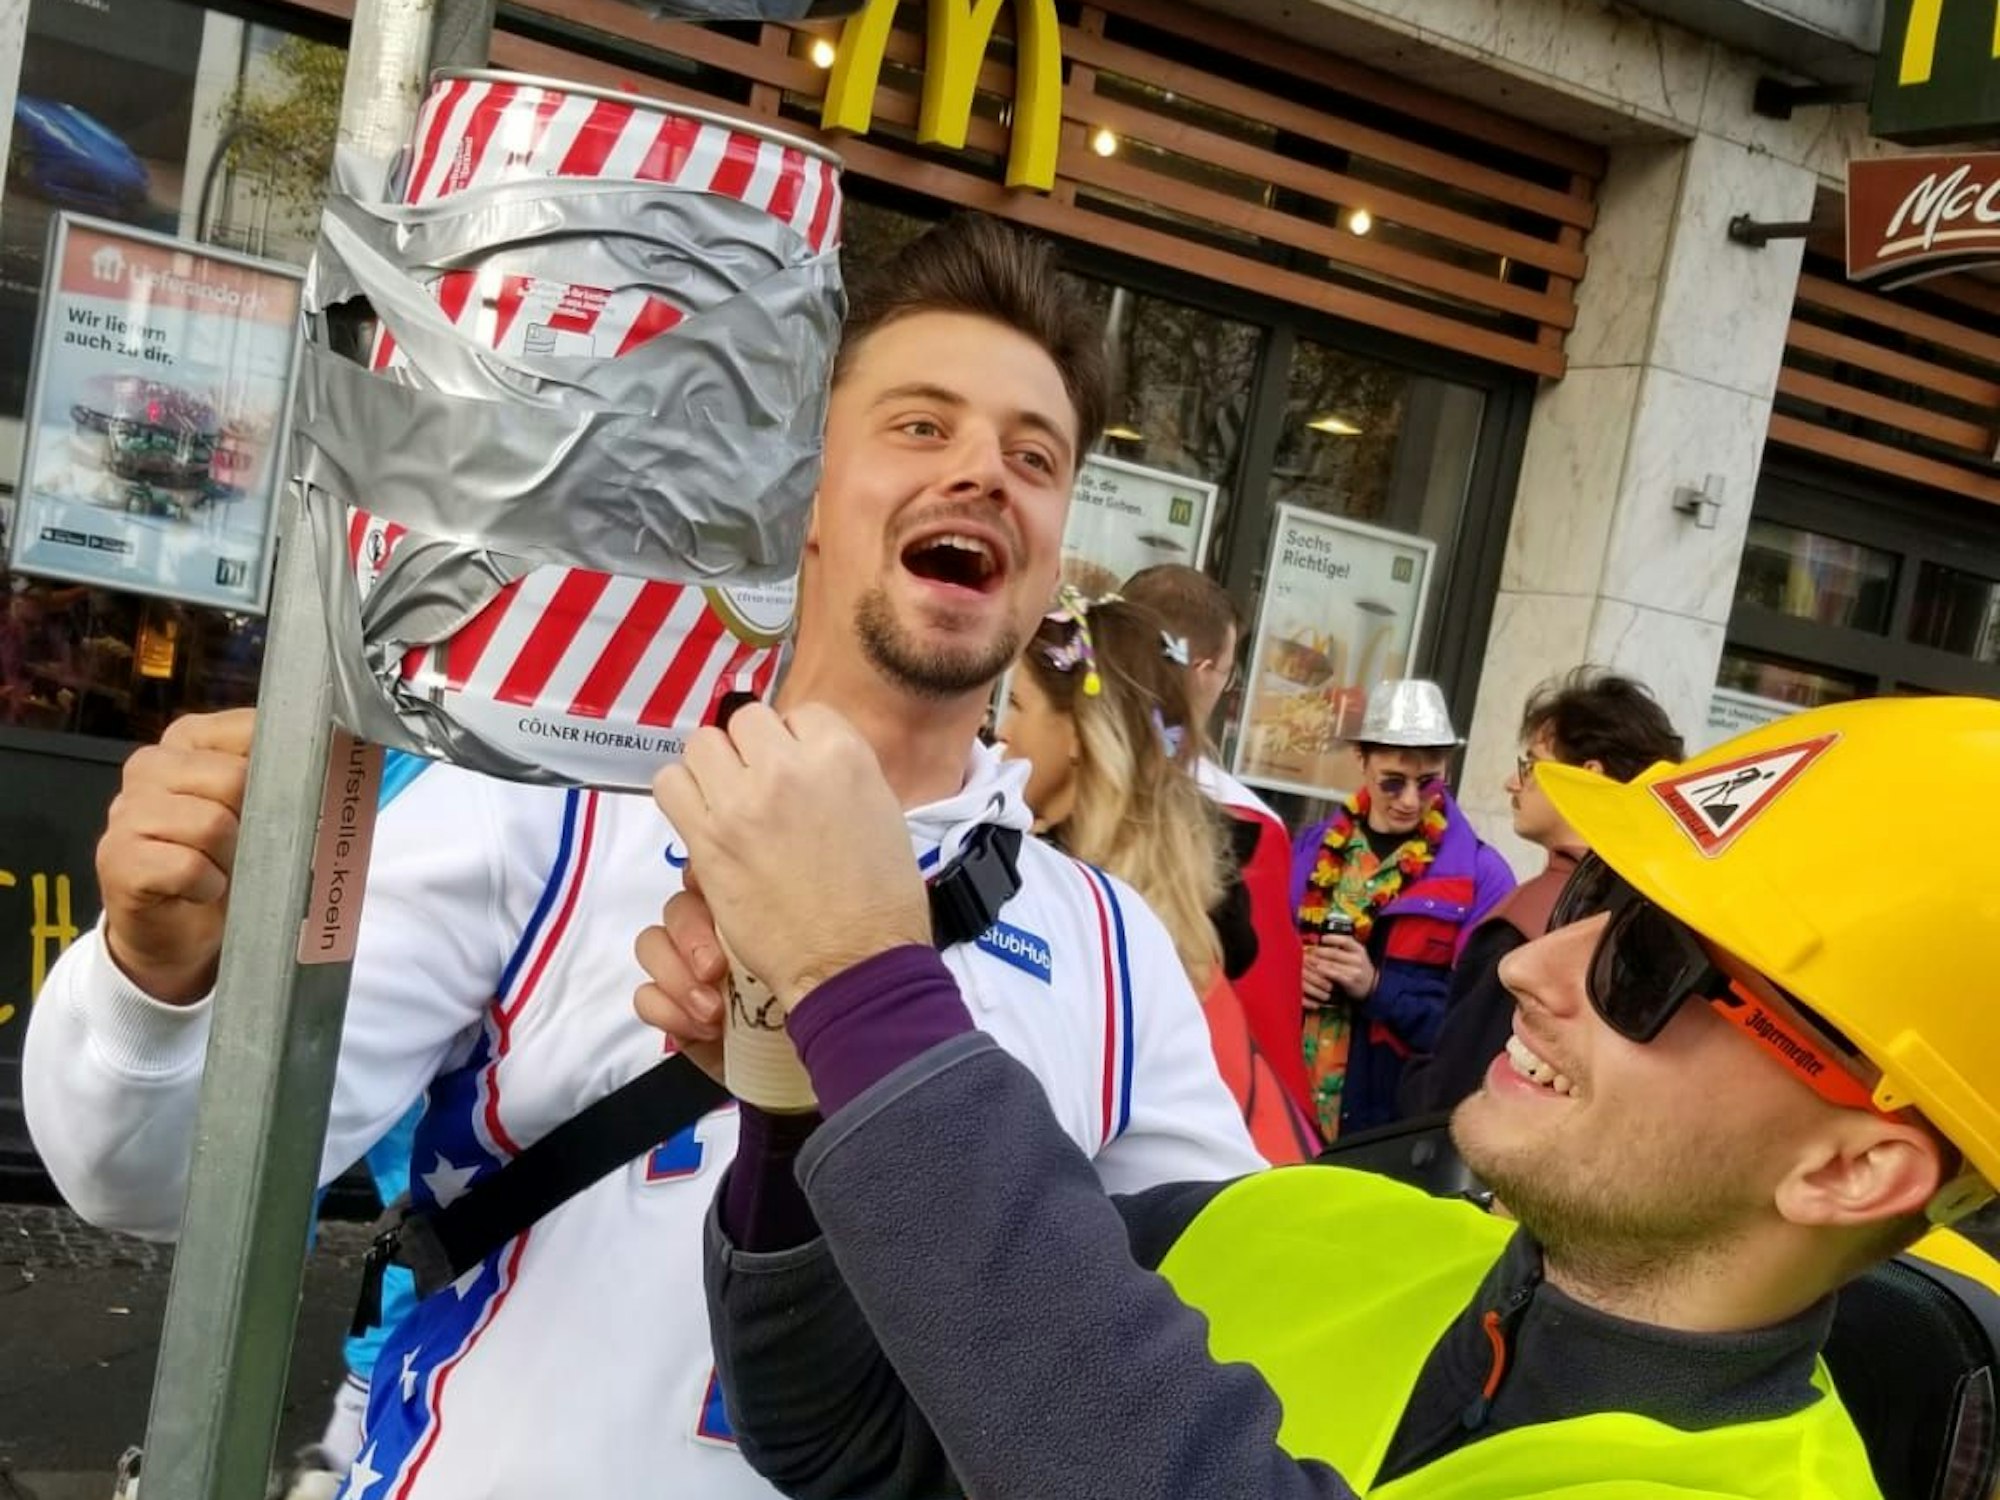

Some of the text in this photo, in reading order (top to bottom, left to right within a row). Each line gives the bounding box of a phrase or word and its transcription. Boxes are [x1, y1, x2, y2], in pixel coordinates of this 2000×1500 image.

[68, 307, 167, 342] Wir liern
[64, 330, 112, 351] auch
[144, 345, 174, 366] dir.
[1286, 529, 1333, 554] Sechs
[1282, 548, 1351, 580] Richtige!
[583, 730, 654, 751] HOFBRÄU
